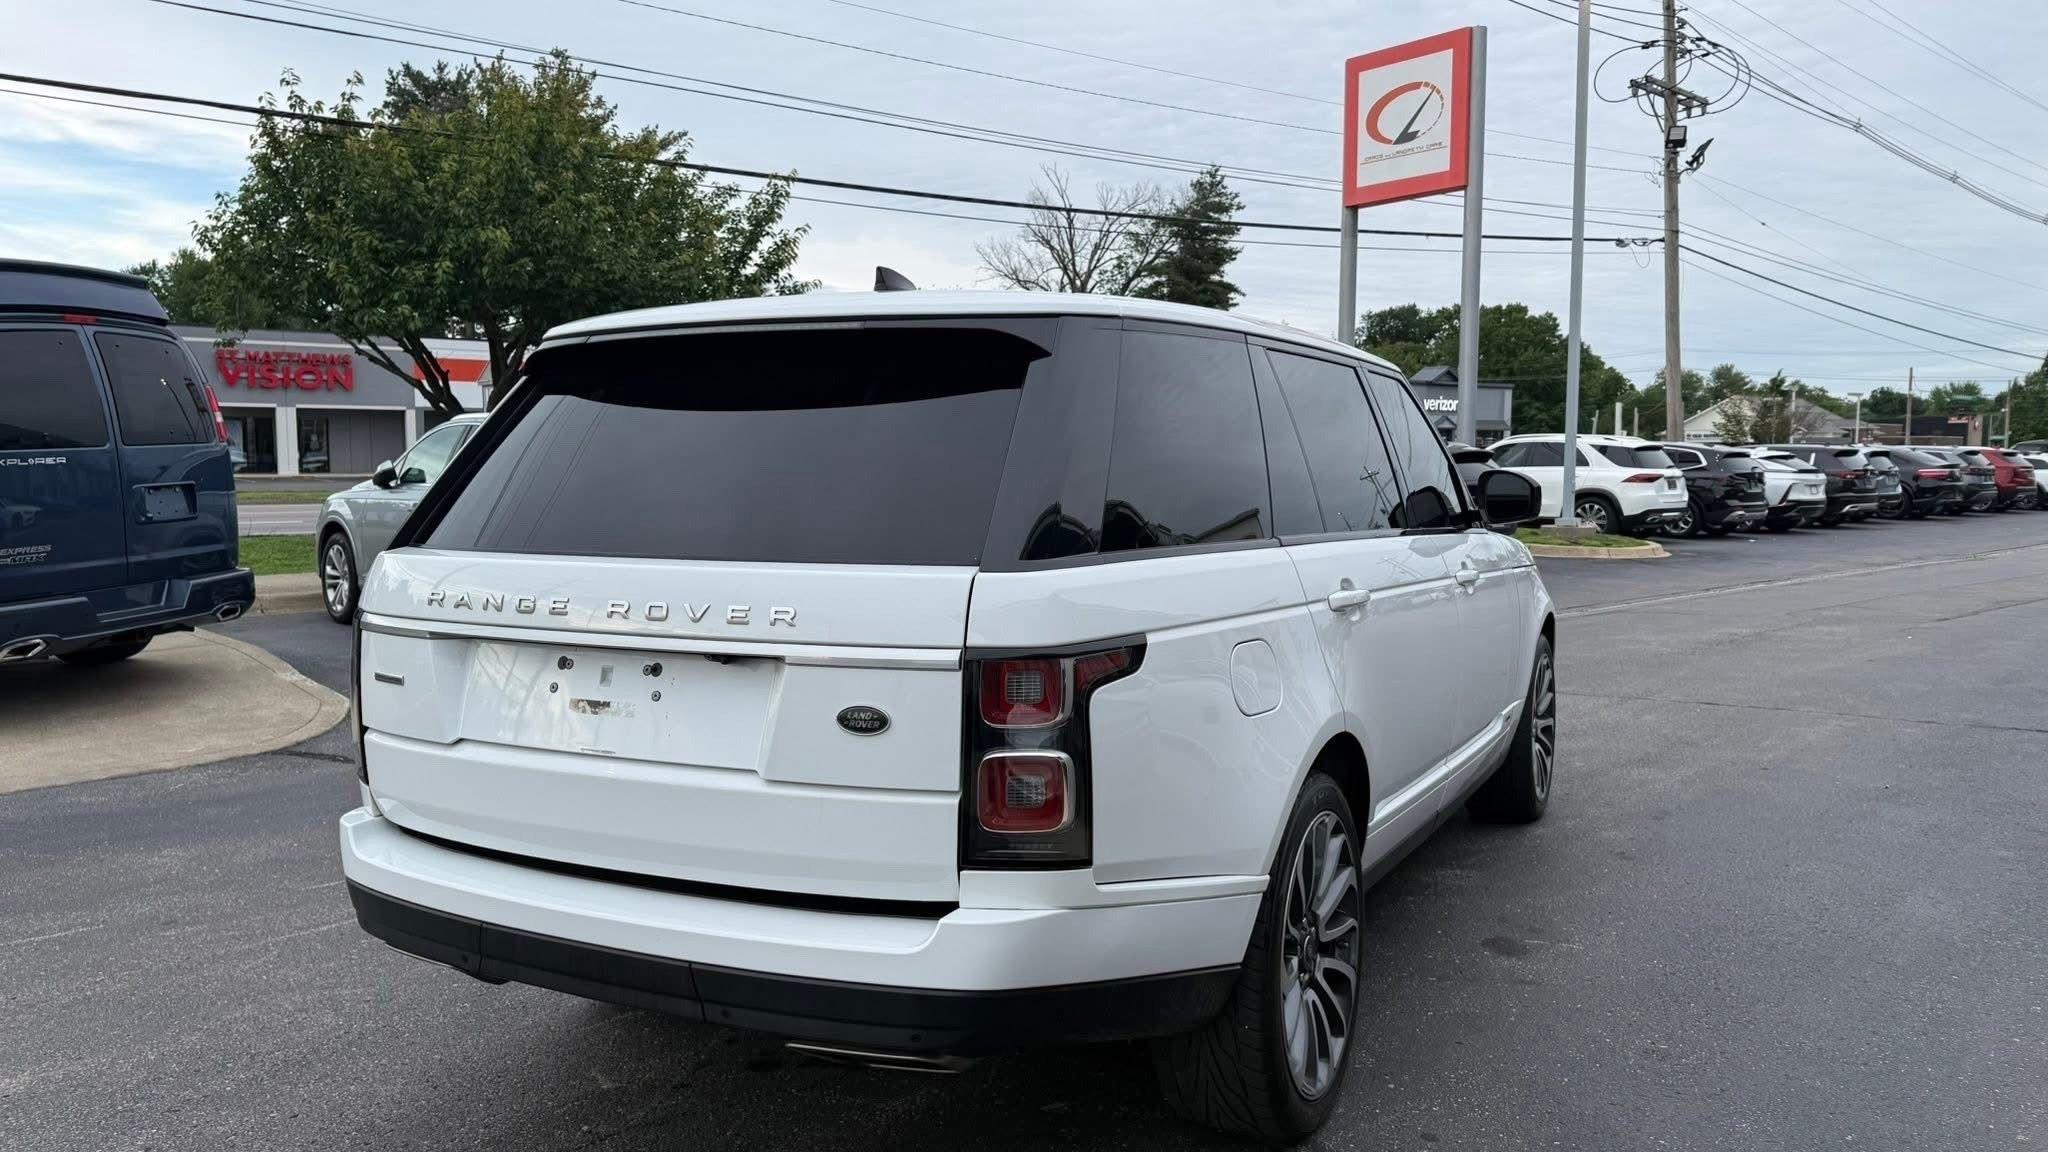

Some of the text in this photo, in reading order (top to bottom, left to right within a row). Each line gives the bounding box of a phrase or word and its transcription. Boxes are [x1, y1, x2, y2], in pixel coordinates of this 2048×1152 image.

[245, 350, 352, 366] MATTHEWS
[216, 359, 353, 391] VISION
[427, 590, 796, 627] RANGE ROVER
